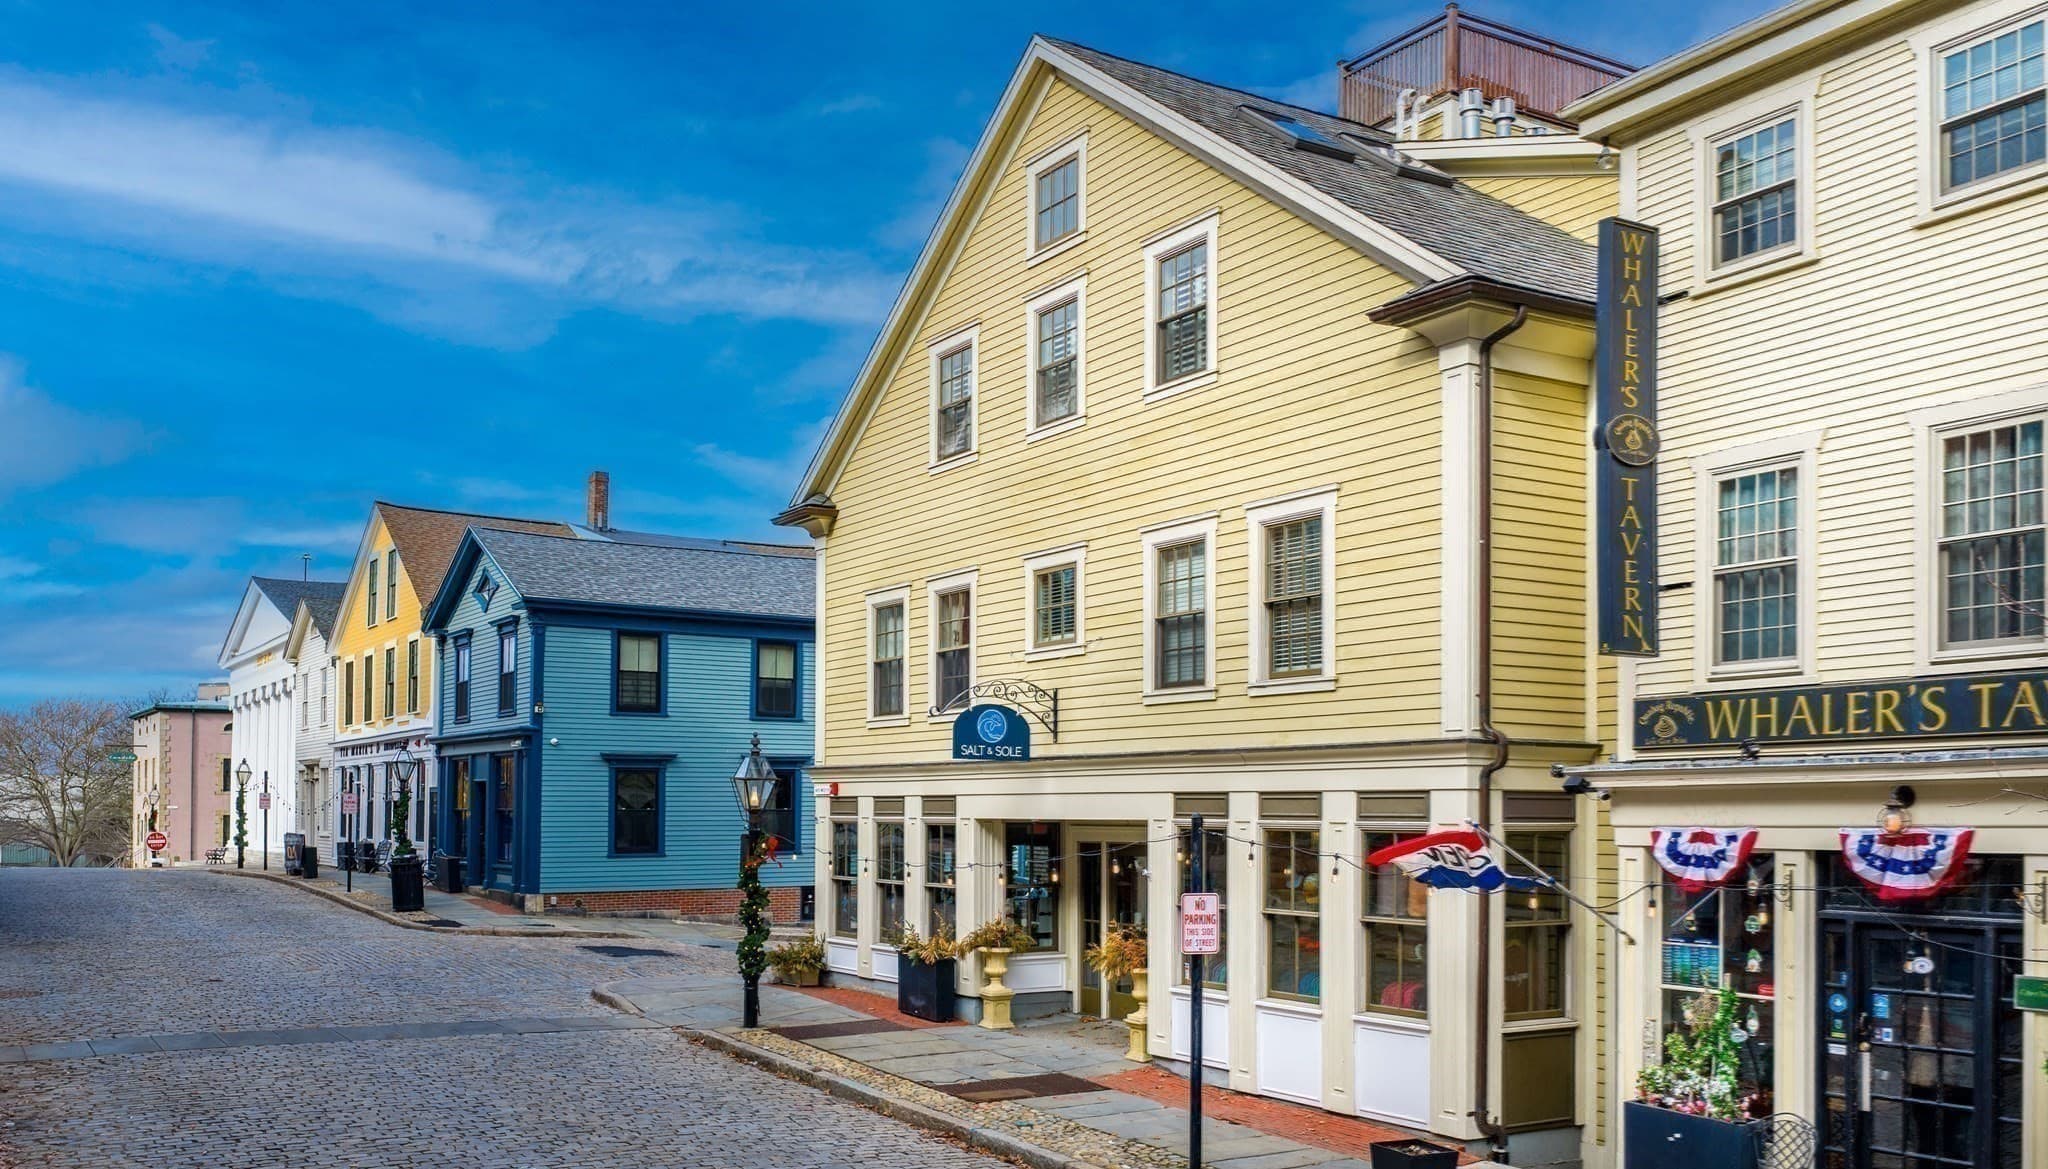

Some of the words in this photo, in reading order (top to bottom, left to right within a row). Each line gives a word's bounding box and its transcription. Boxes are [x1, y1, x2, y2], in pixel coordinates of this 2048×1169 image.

[1620, 229, 1647, 409] WHALER'S
[1619, 477, 1651, 652] TAVERN
[1704, 684, 1948, 739] WHALER'S
[1968, 680, 2048, 729] TA
[960, 744, 986, 756] SALT
[986, 746, 993, 755] &
[994, 746, 1022, 757] SOLE
[1194, 899, 1206, 911] NO
[1184, 913, 1216, 925] PARKING
[1186, 927, 1199, 936] THIS
[1201, 927, 1214, 936] SIDE
[1185, 938, 1193, 947] OF
[1194, 938, 1215, 947] STREET
